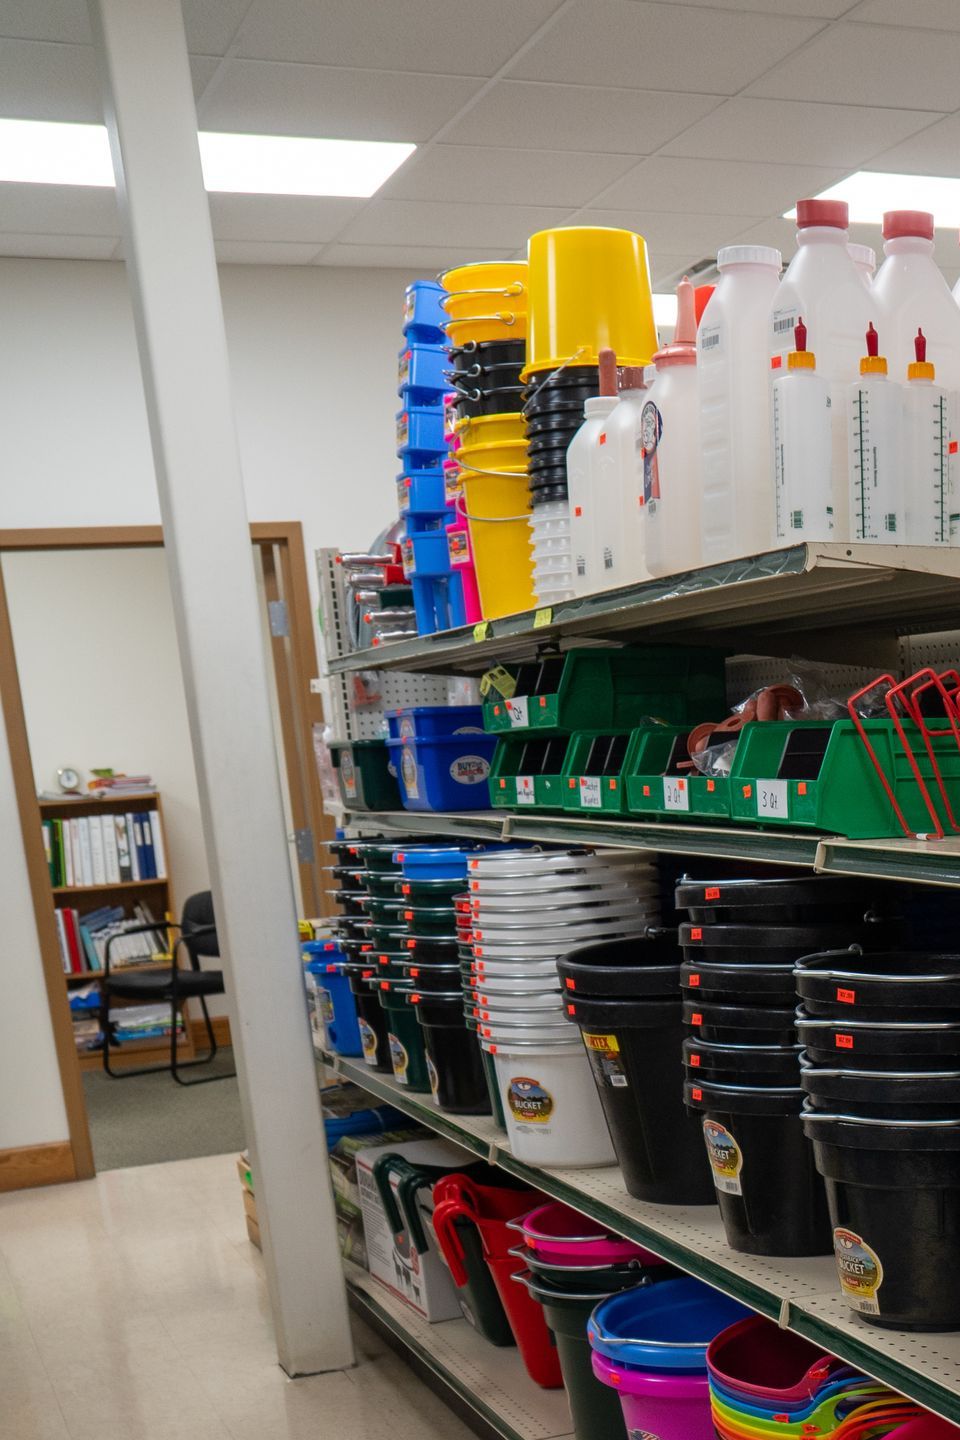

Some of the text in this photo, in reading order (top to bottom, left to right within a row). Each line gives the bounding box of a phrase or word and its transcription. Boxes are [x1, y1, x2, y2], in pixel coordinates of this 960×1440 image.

[761, 790, 778, 810] 3 Qt
[514, 1099, 542, 1110] BUCKET
